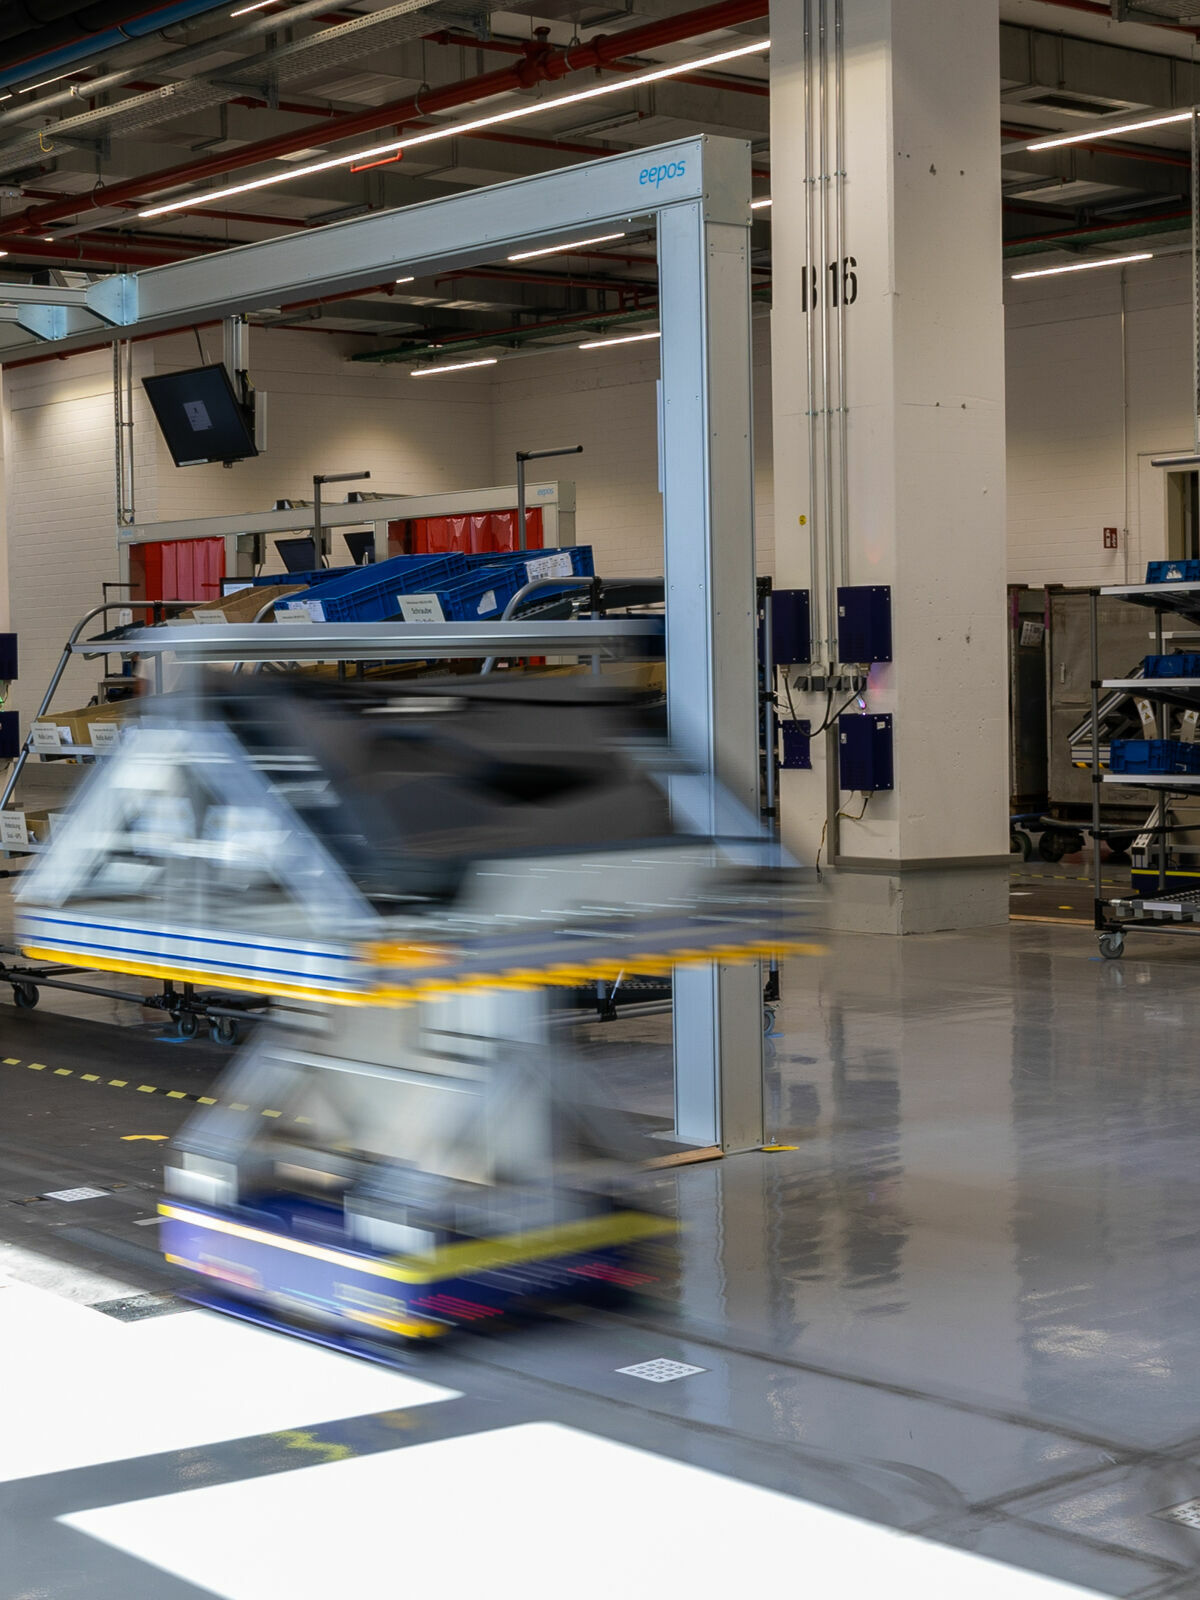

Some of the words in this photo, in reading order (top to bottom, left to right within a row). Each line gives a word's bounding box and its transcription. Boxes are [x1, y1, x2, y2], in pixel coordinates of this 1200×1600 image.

[639, 161, 685, 189] eepos
[801, 265, 818, 313] B
[829, 256, 858, 308] 16
